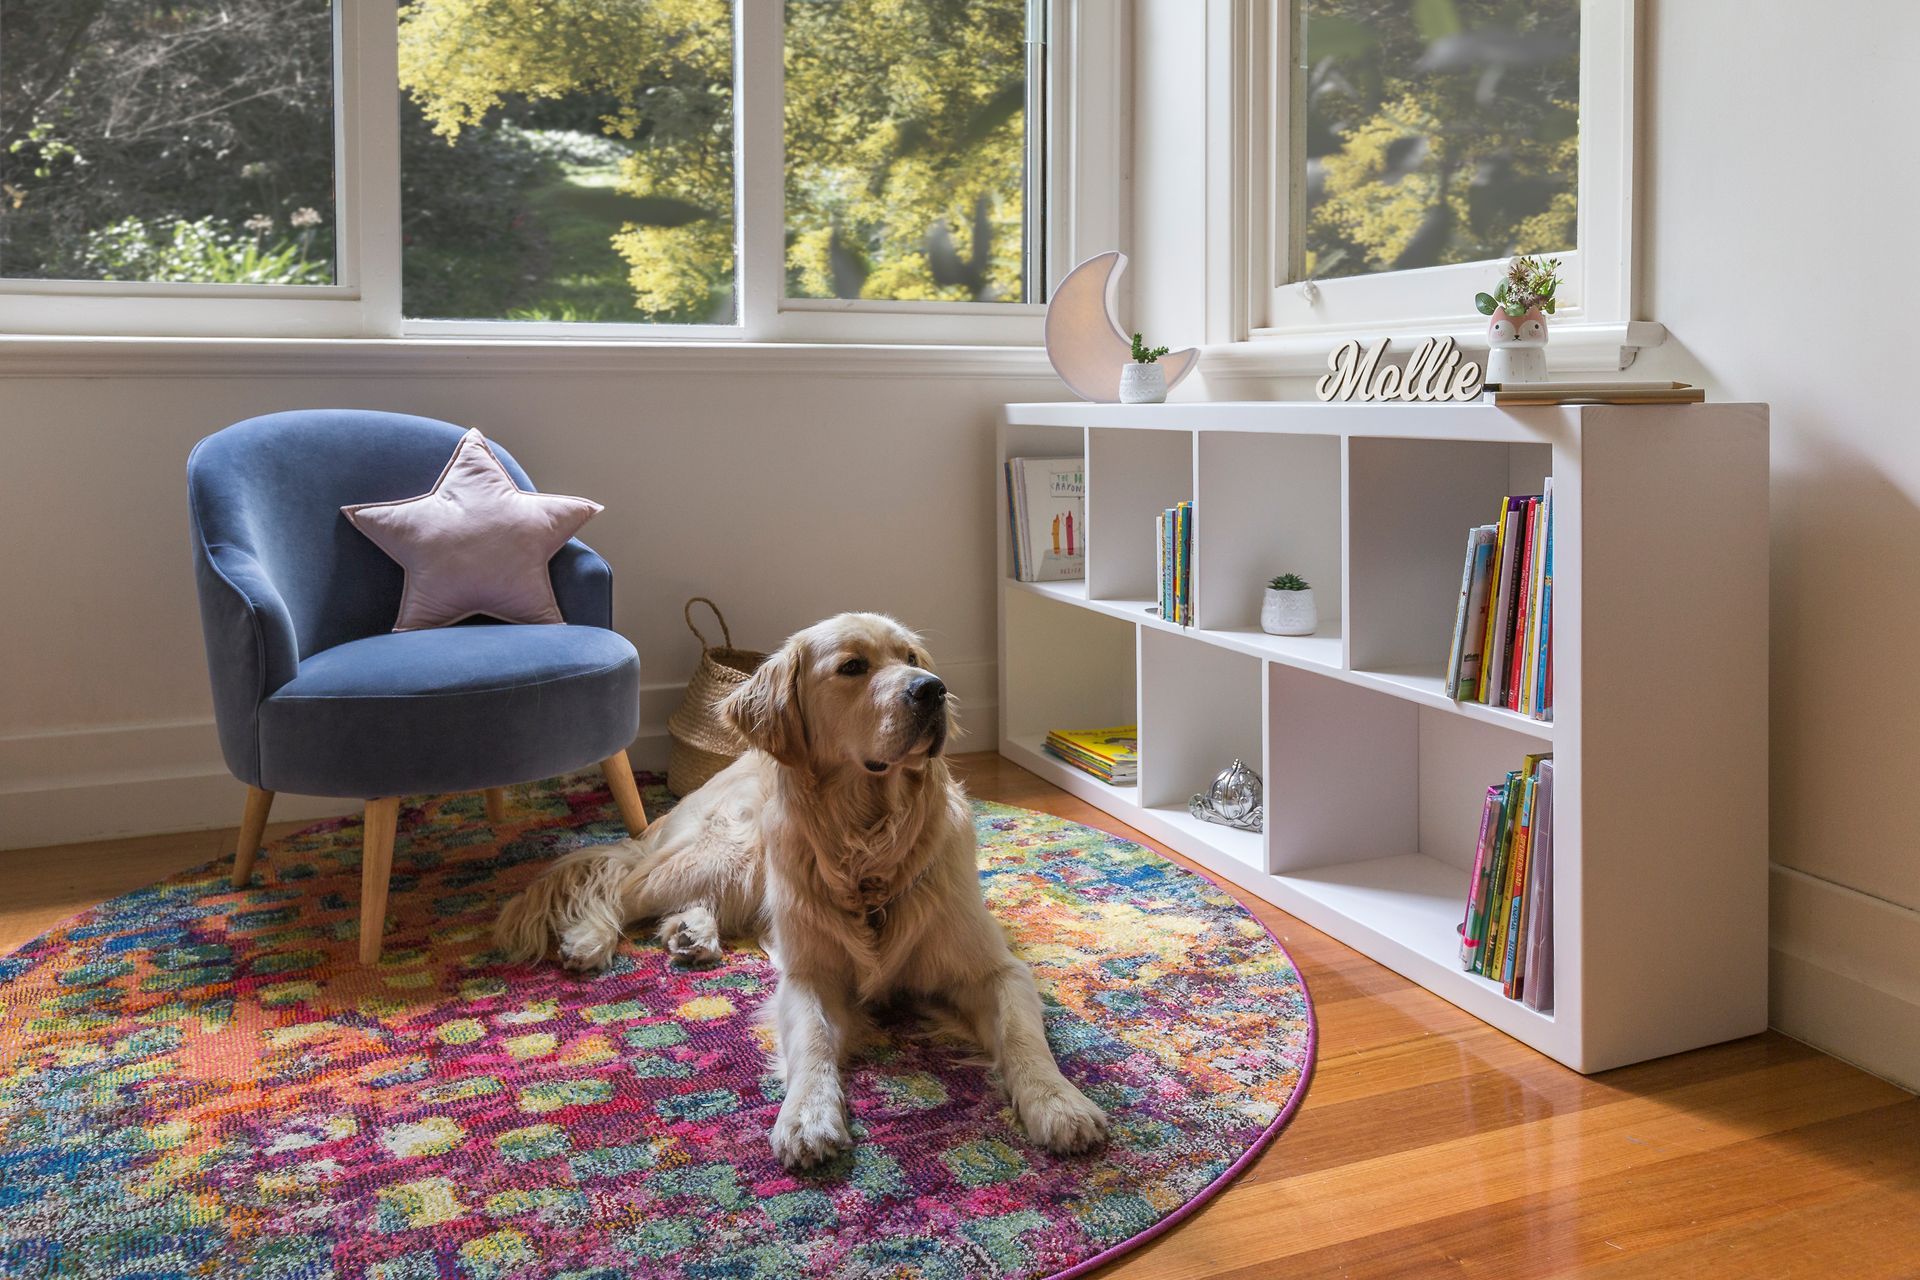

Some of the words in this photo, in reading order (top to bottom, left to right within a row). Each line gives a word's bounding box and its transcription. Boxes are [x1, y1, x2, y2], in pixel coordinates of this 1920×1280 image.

[1315, 336, 1483, 402] Mollie
[1517, 832, 1527, 871] SUPERHERO
[1514, 871, 1522, 886] DAD
